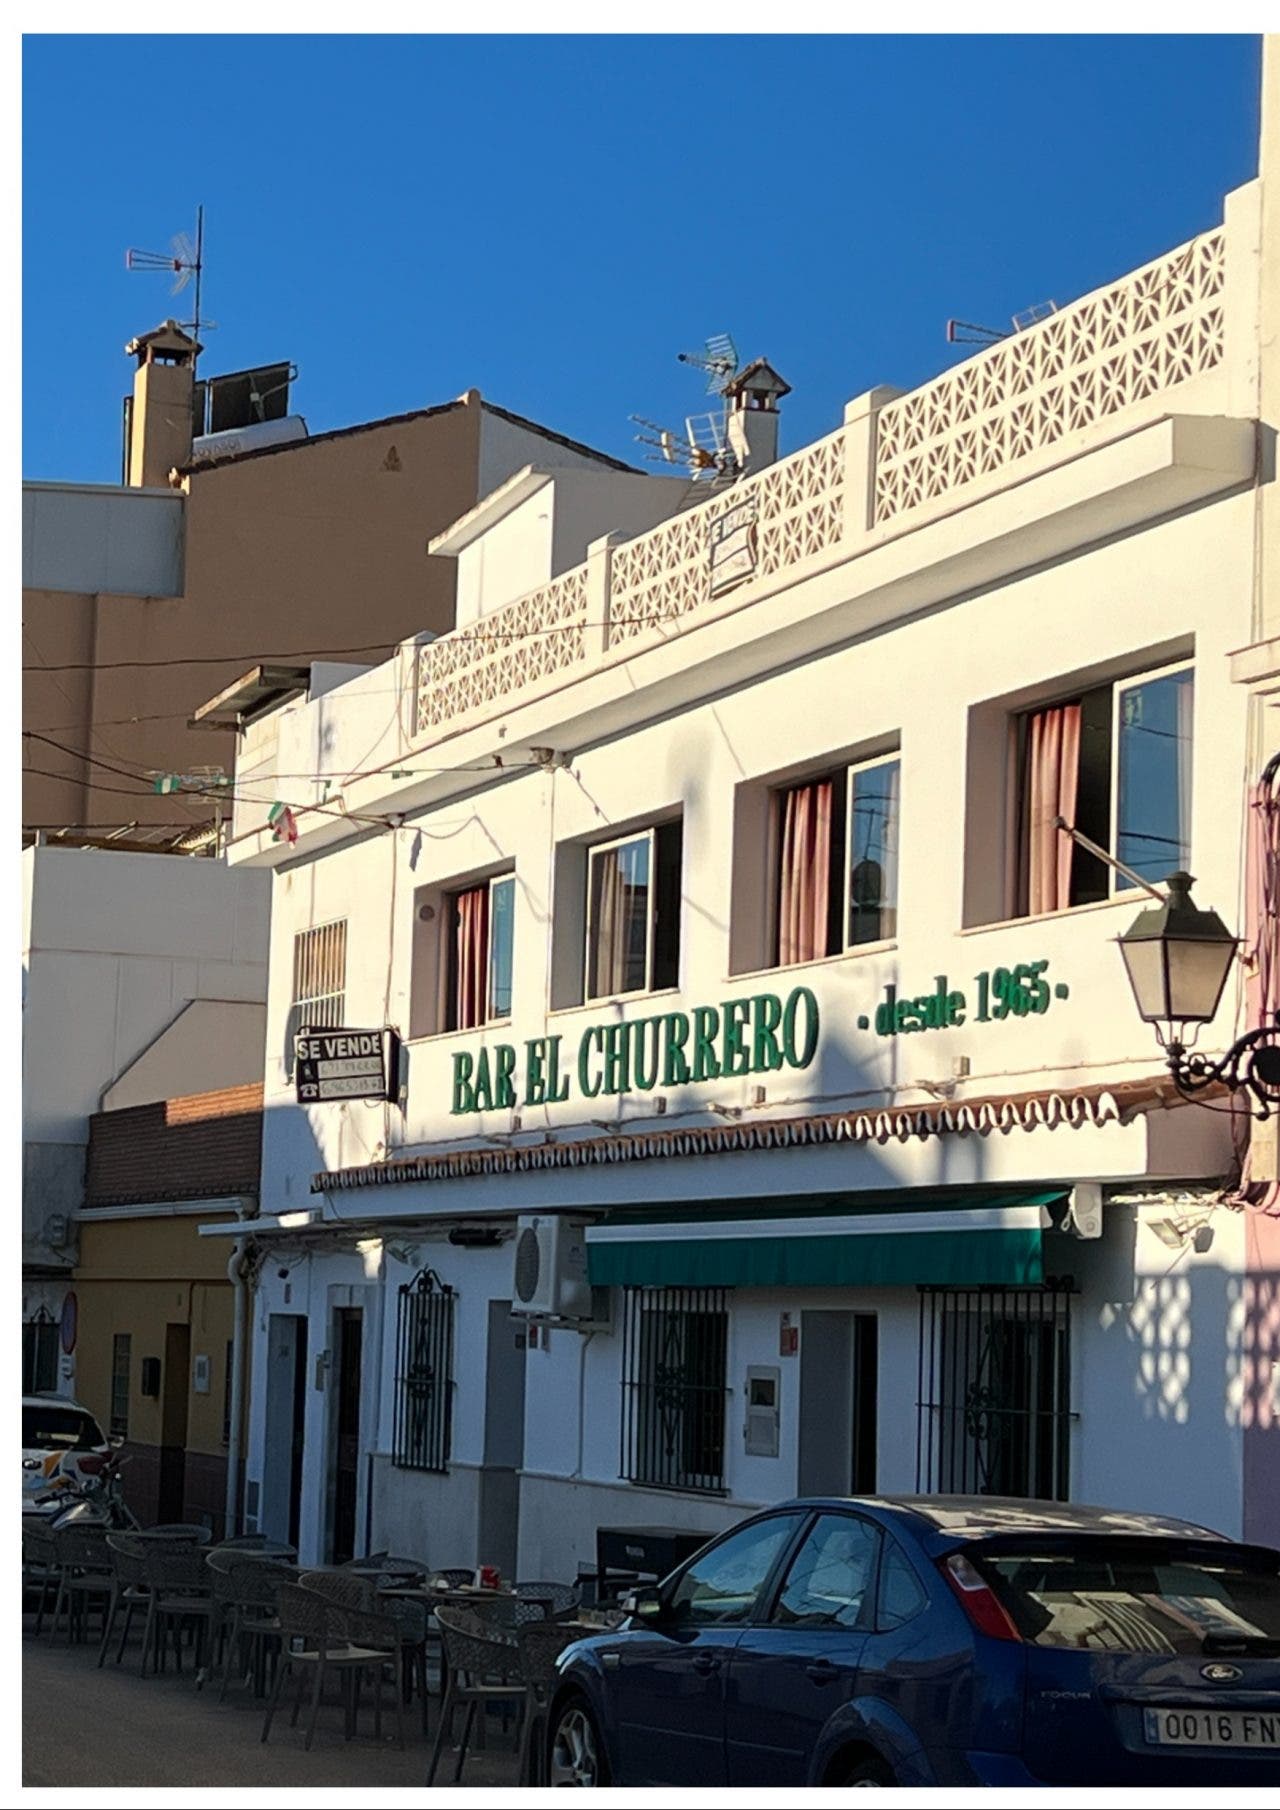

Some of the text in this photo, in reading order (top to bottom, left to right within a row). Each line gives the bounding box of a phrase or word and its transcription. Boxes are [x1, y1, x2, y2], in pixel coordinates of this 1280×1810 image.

[875, 959, 1051, 1037] desde 1965
[298, 1034, 381, 1060] SE VENDE
[450, 986, 820, 1115] BAR EL CHURRERO
[1165, 1713, 1233, 1742] 0016
